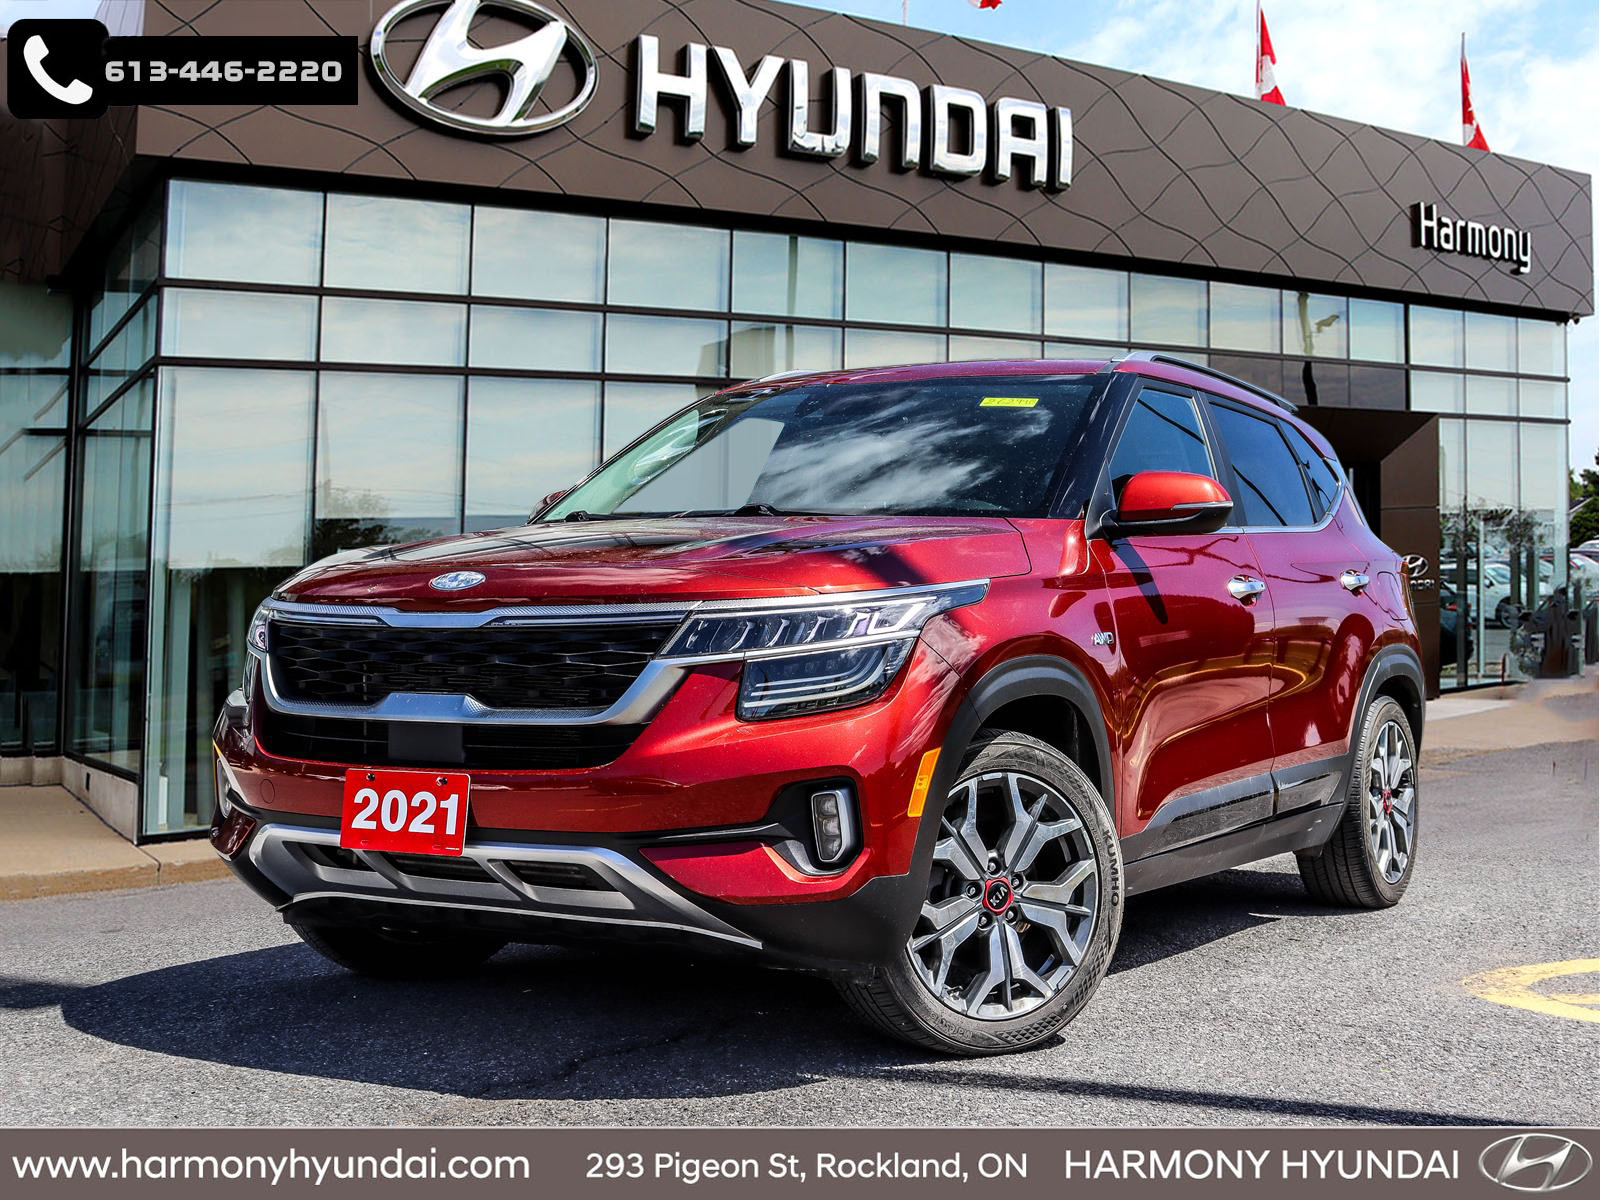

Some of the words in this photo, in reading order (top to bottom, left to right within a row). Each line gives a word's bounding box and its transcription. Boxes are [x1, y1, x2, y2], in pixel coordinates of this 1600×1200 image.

[635, 33, 1074, 191] HYUNDAI
[1419, 201, 1532, 274] Harmony
[1092, 631, 1114, 646] AWD
[351, 787, 459, 836] 2021
[989, 886, 1008, 907] KIA
[1102, 828, 1120, 907] KUMHO
